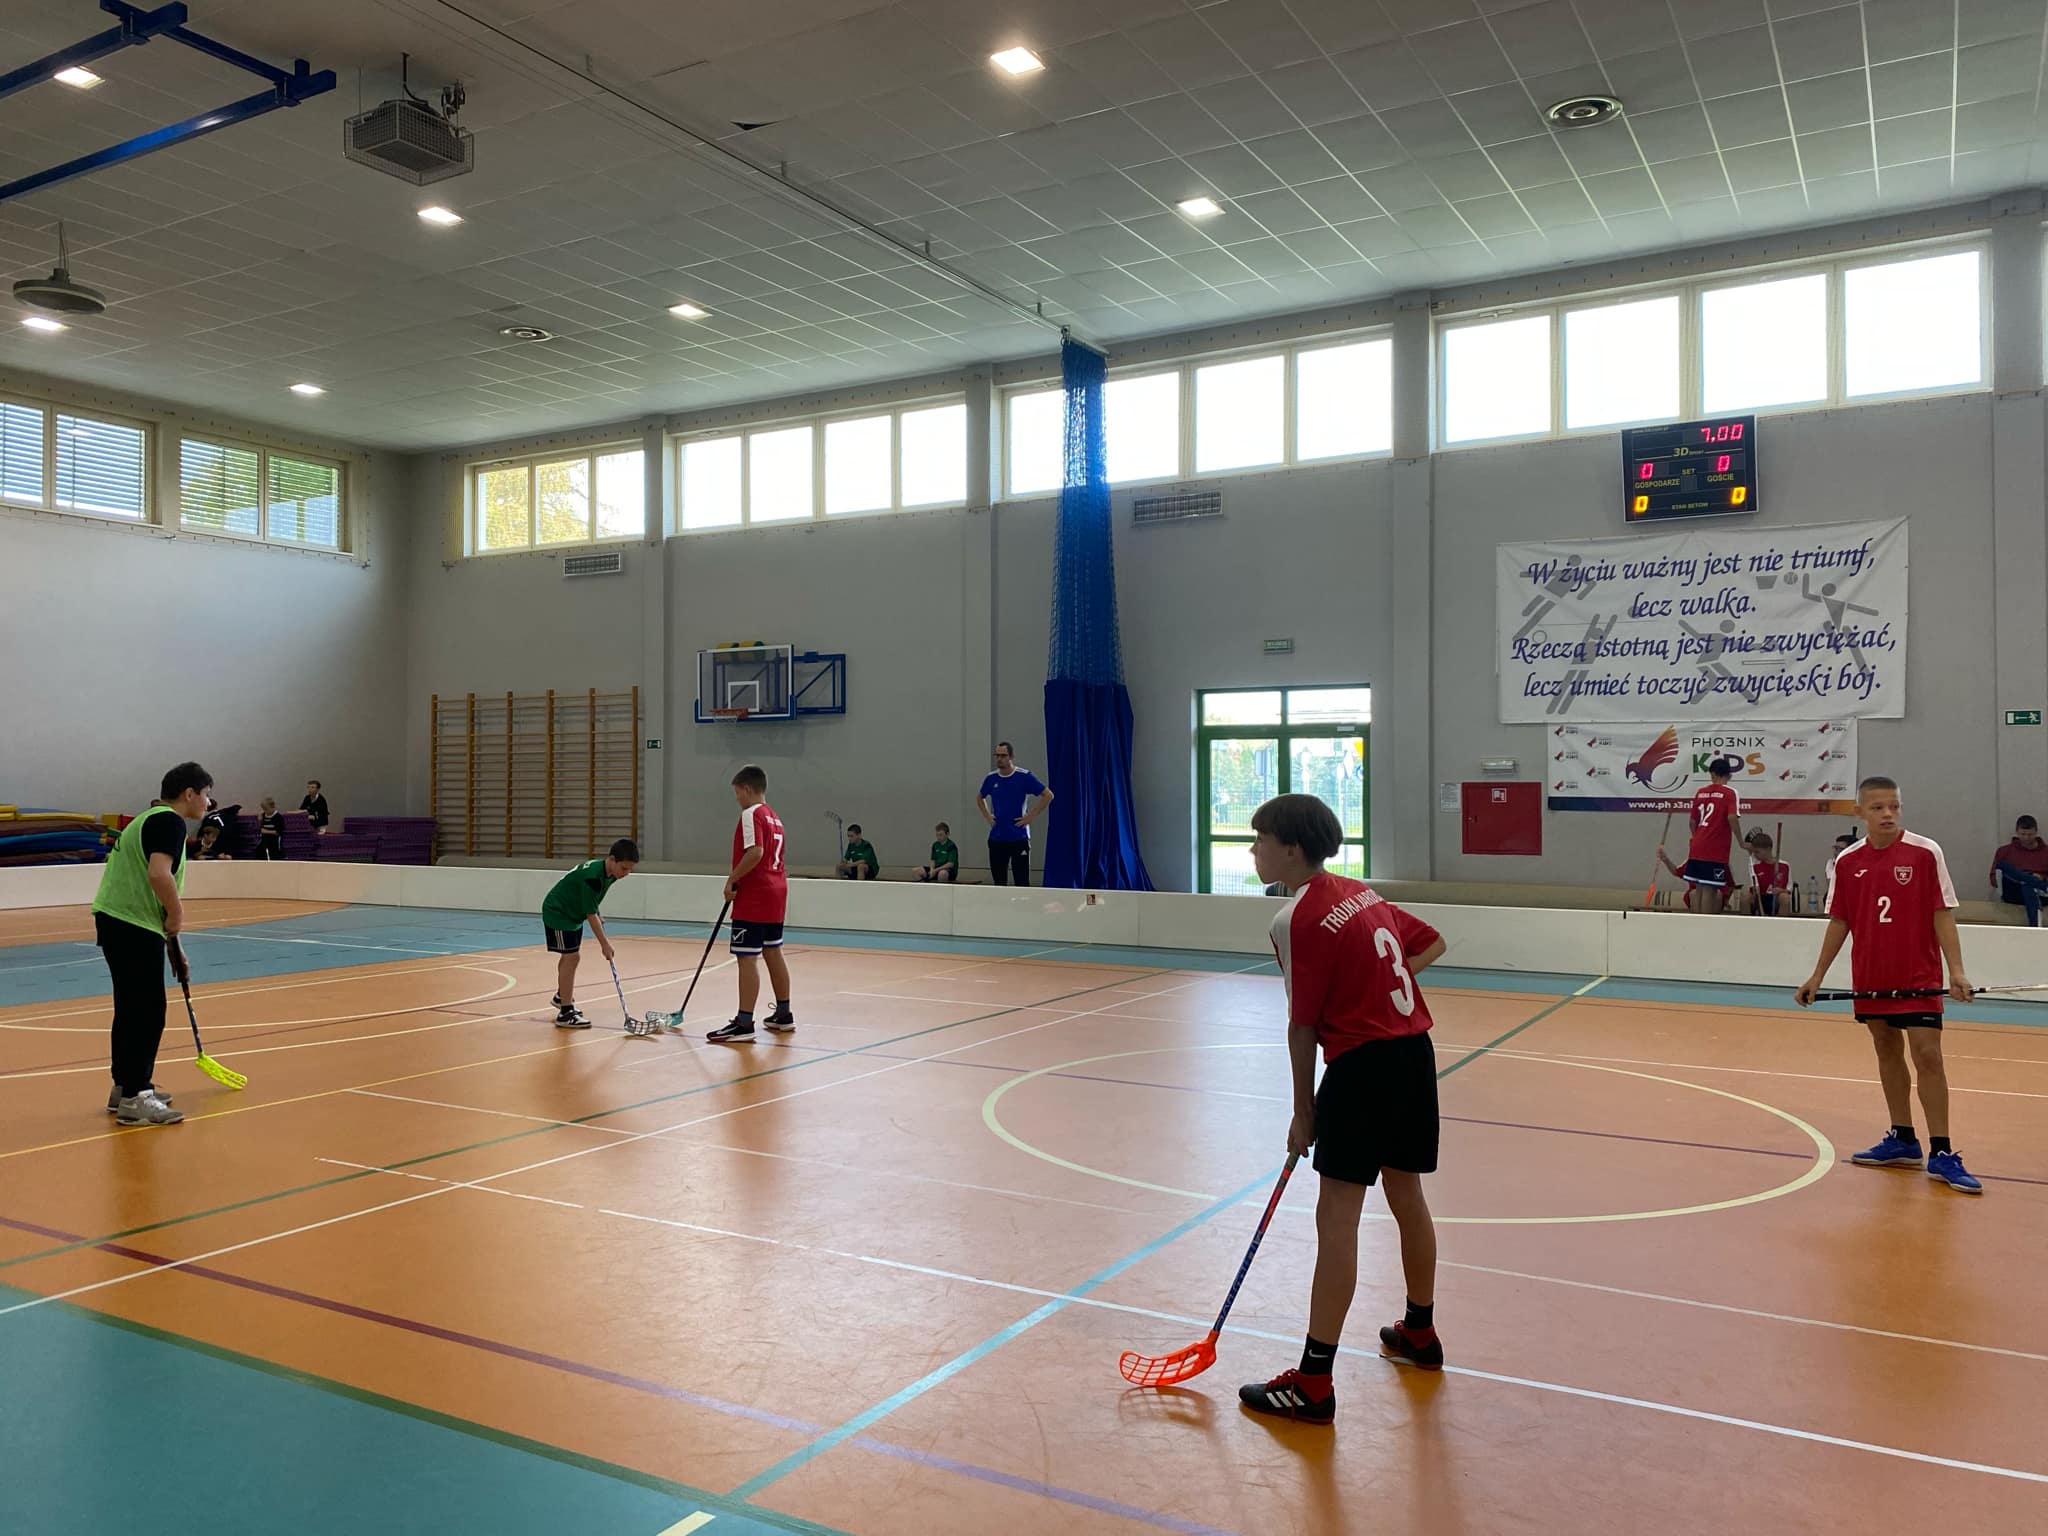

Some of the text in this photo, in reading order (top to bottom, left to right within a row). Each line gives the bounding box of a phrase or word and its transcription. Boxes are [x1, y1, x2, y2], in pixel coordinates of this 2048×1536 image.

[1641, 463, 1653, 479] 0
[1717, 455, 1730, 472] 0
[1635, 479, 1680, 488] GOSPODARZE
[1731, 486, 1746, 504] 0
[1634, 496, 1649, 512] 0
[1528, 538, 1875, 592] W życiu ważny jest nie triumf,
[1632, 587, 1757, 619] lecz walka.
[1511, 622, 1897, 666] Rzeczą istotną jest nie zwyciężać,
[1524, 662, 1882, 705] lecz umieć toczyć zwycięski bój.
[1698, 802, 1715, 827] 12
[773, 832, 783, 870] 7
[1320, 897, 1363, 934] TRÓJKA
[1877, 895, 1892, 923] 2
[1373, 927, 1415, 1016] 3
